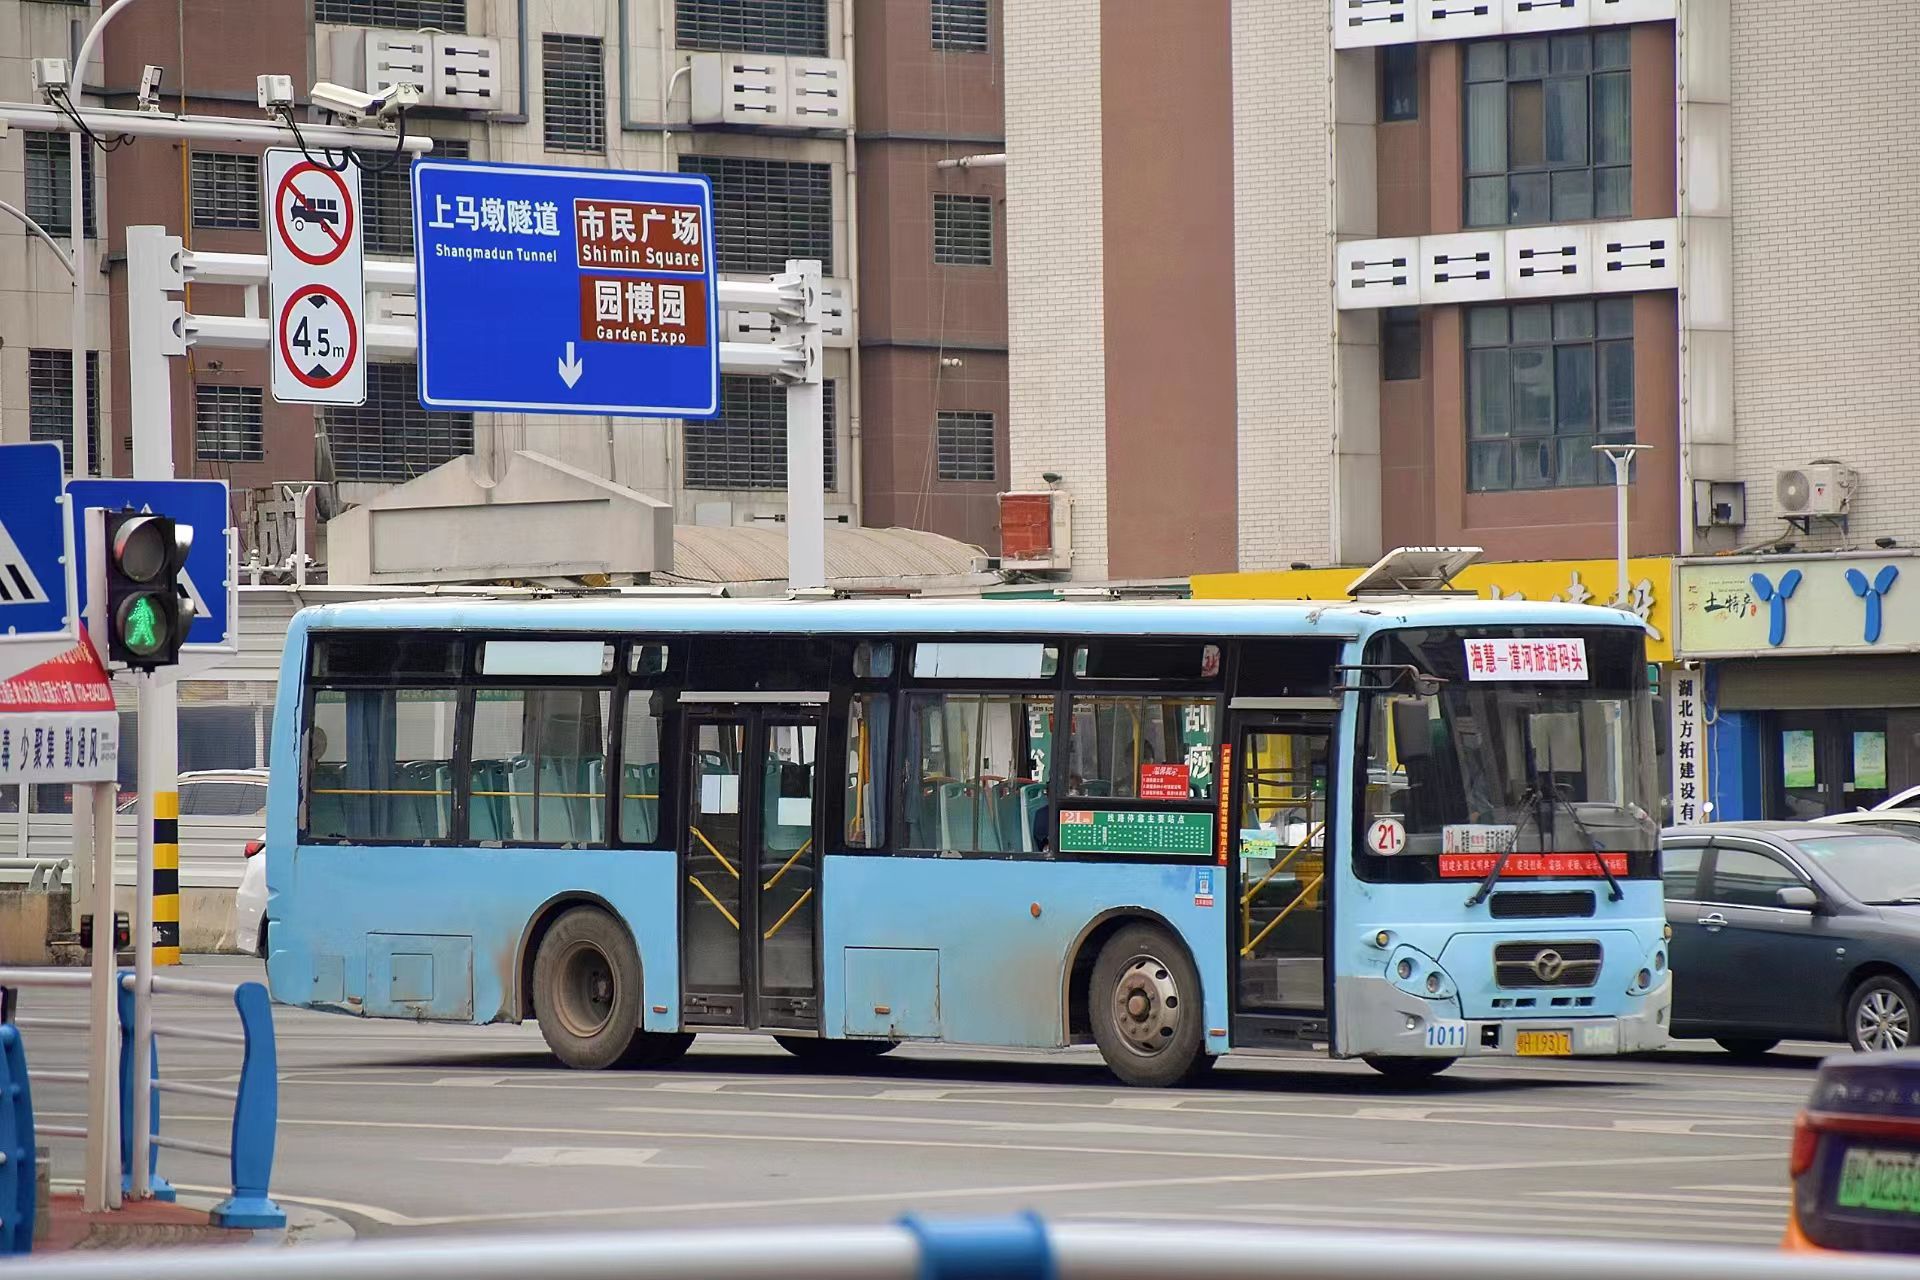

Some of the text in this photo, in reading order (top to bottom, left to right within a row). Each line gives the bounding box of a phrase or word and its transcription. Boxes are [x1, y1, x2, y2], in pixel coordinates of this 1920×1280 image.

[429, 194, 560, 236] 上马墩隧道
[578, 205, 699, 245] 市民广场
[435, 243, 557, 262] Shangmadun Tunnel
[582, 244, 699, 268] Shimin Square
[595, 280, 685, 326] 园博园
[596, 325, 686, 345] Garden Expo
[1704, 591, 1752, 618] 土特产
[1378, 824, 1394, 849] 21
[1427, 1025, 1465, 1046] 1011
